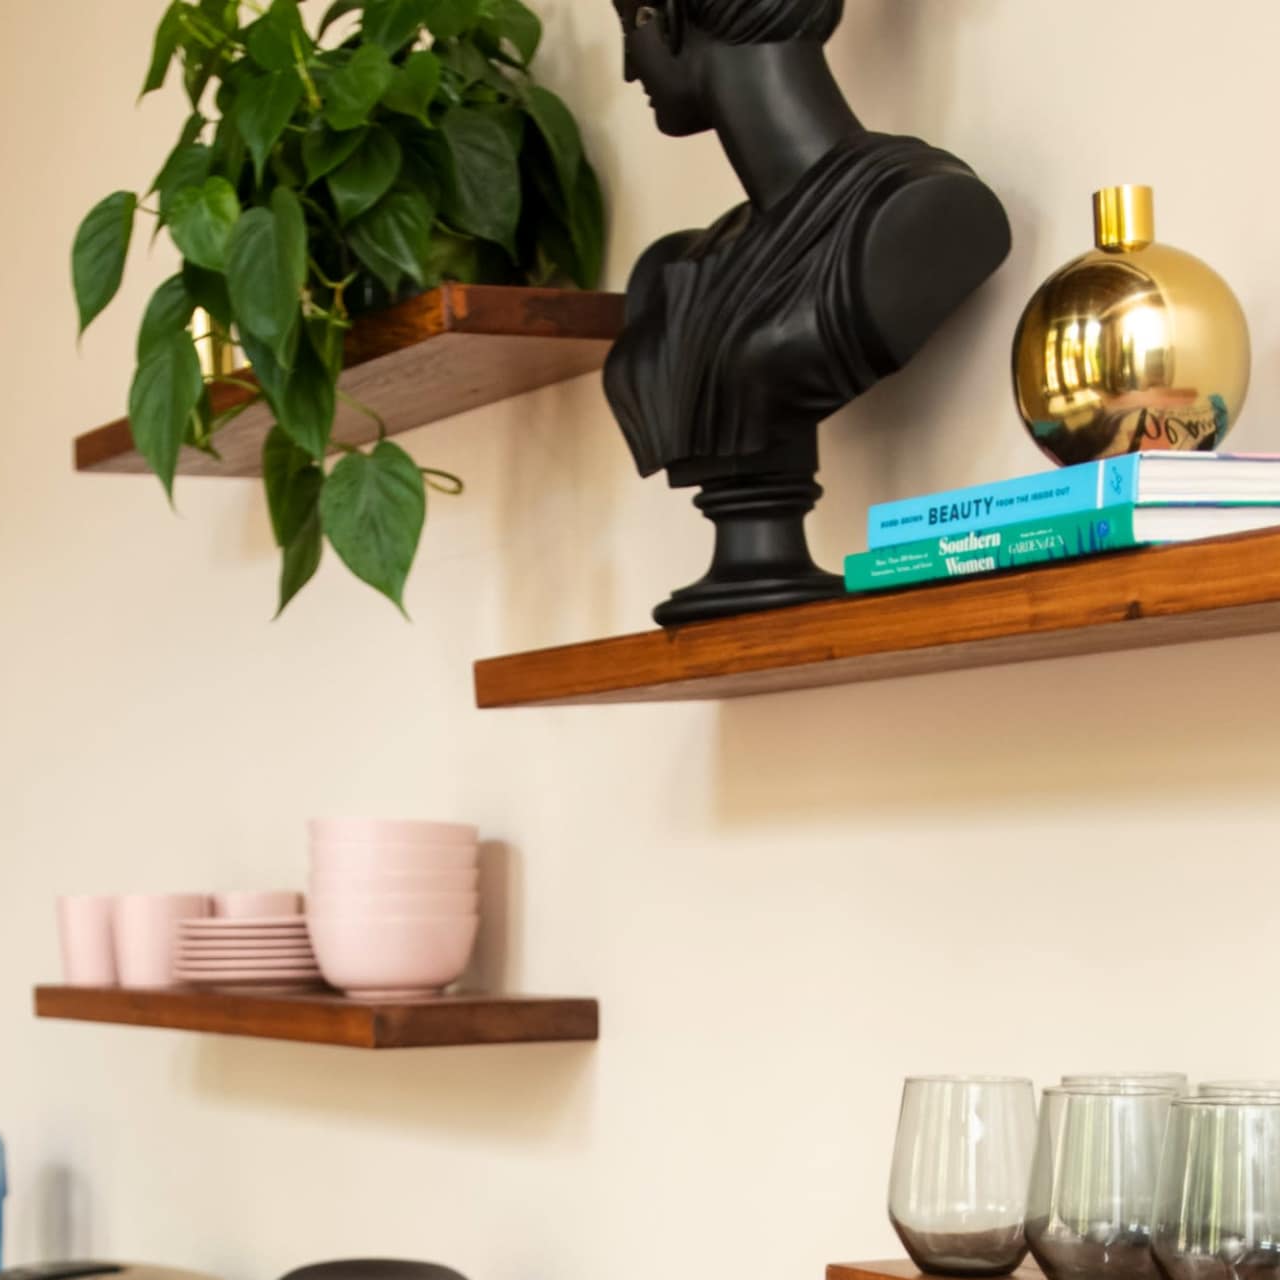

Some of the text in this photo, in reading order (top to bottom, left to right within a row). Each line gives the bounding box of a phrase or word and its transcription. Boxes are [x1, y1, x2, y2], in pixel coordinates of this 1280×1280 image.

[928, 496, 995, 526] BEAUTY
[938, 530, 1002, 557] Southern
[944, 556, 996, 577] Women
